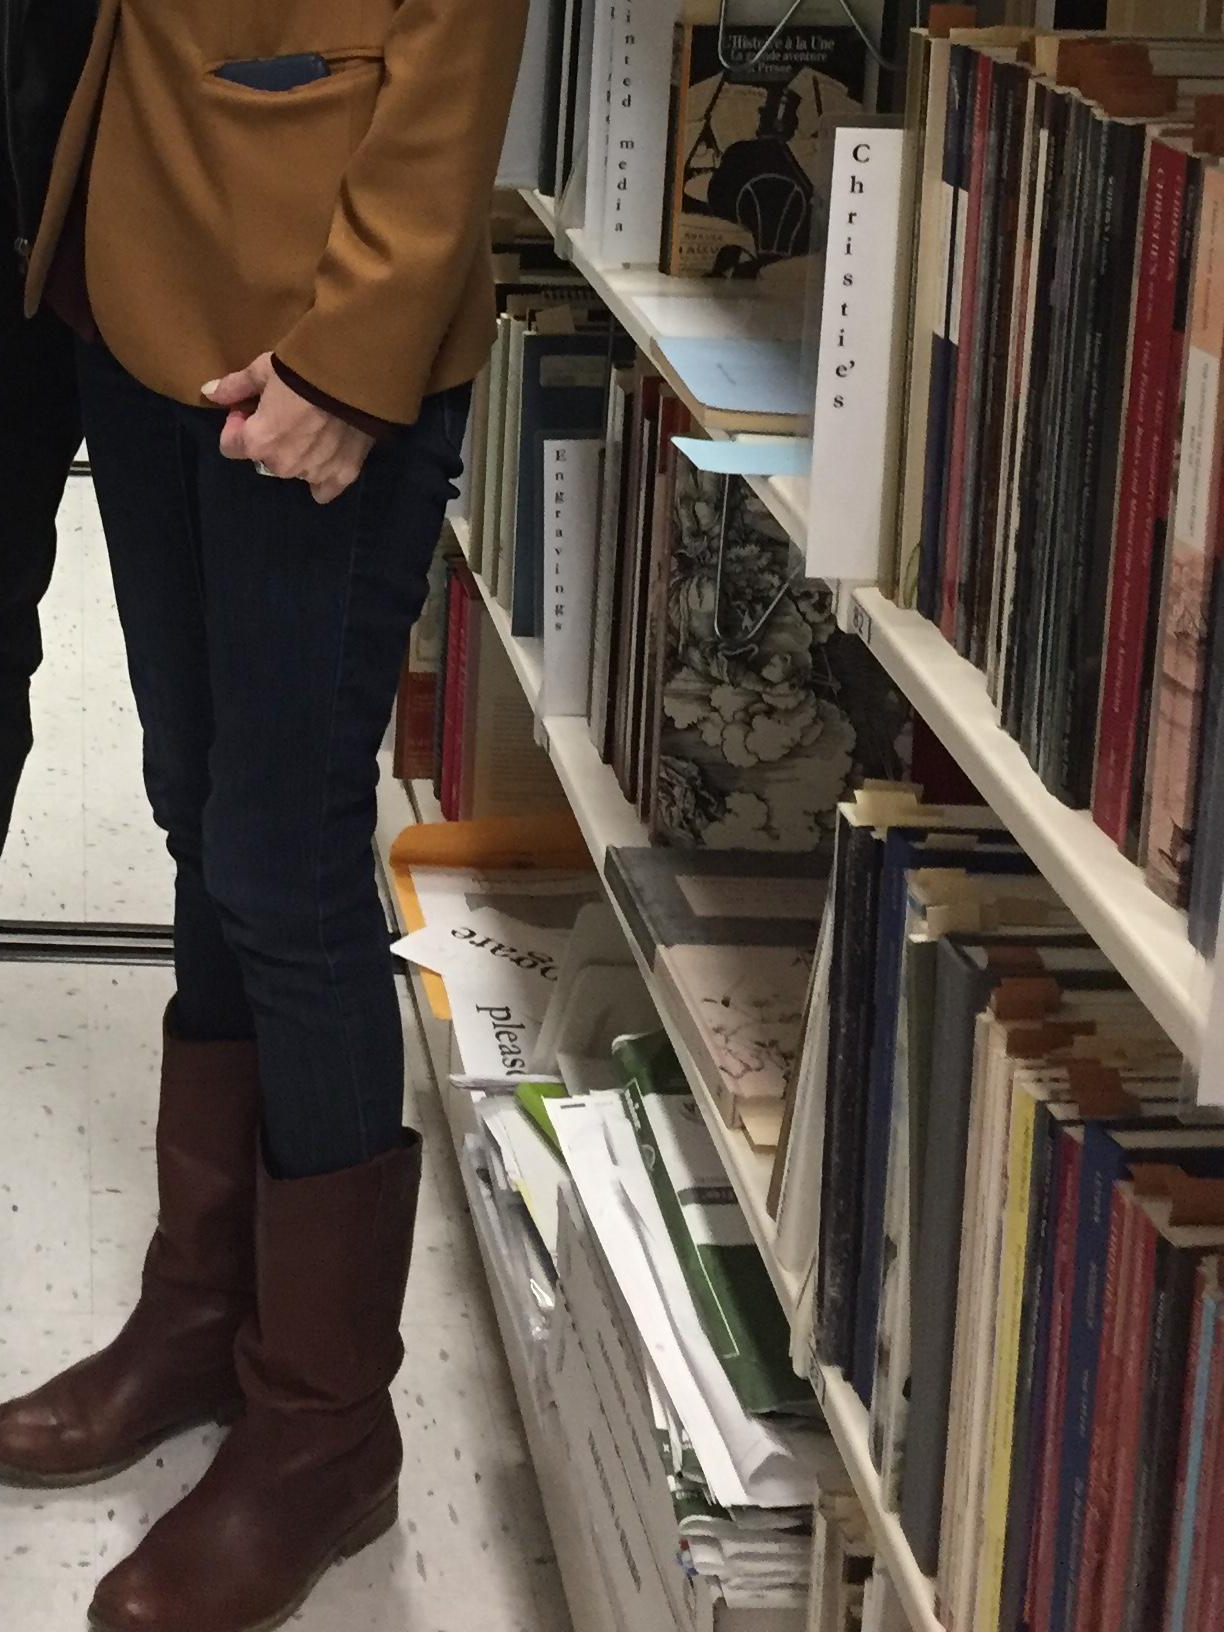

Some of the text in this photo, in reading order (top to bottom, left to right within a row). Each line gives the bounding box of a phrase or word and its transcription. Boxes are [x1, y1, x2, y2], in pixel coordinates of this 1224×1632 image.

[811, 35, 836, 51] Une
[613, 139, 636, 233] media
[831, 142, 873, 411] Christie's
[553, 447, 567, 634] Engravings
